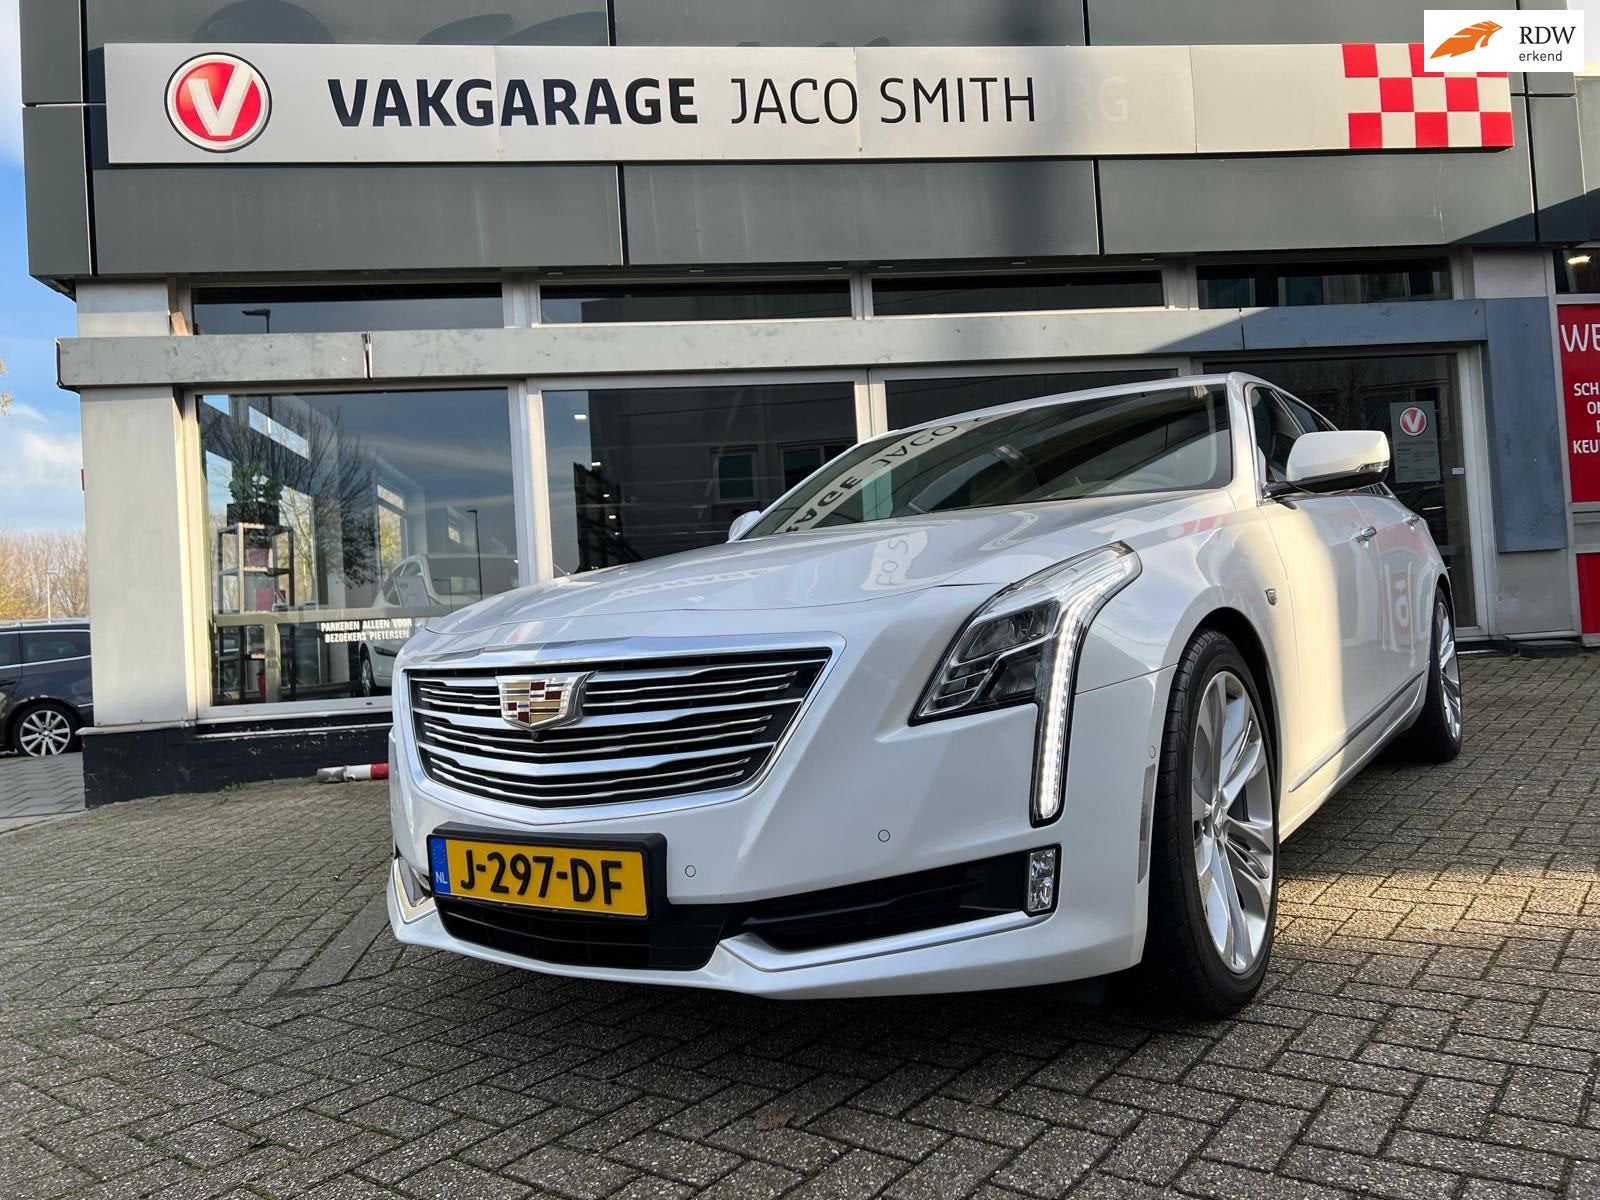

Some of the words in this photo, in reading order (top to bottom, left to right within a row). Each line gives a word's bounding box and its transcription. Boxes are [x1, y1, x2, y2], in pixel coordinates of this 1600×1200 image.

[327, 78, 698, 127] VAKGARAGE
[730, 78, 858, 125] JACO
[880, 77, 1035, 123] SMITH
[320, 621, 360, 632] PARKEREN
[362, 619, 390, 630] ALLEEN
[391, 618, 412, 629] VOOR
[324, 632, 367, 643] BEZOEKERS
[369, 629, 410, 641] PIETERSEN
[435, 871, 448, 885] NL
[460, 850, 623, 905] J-297-DF
